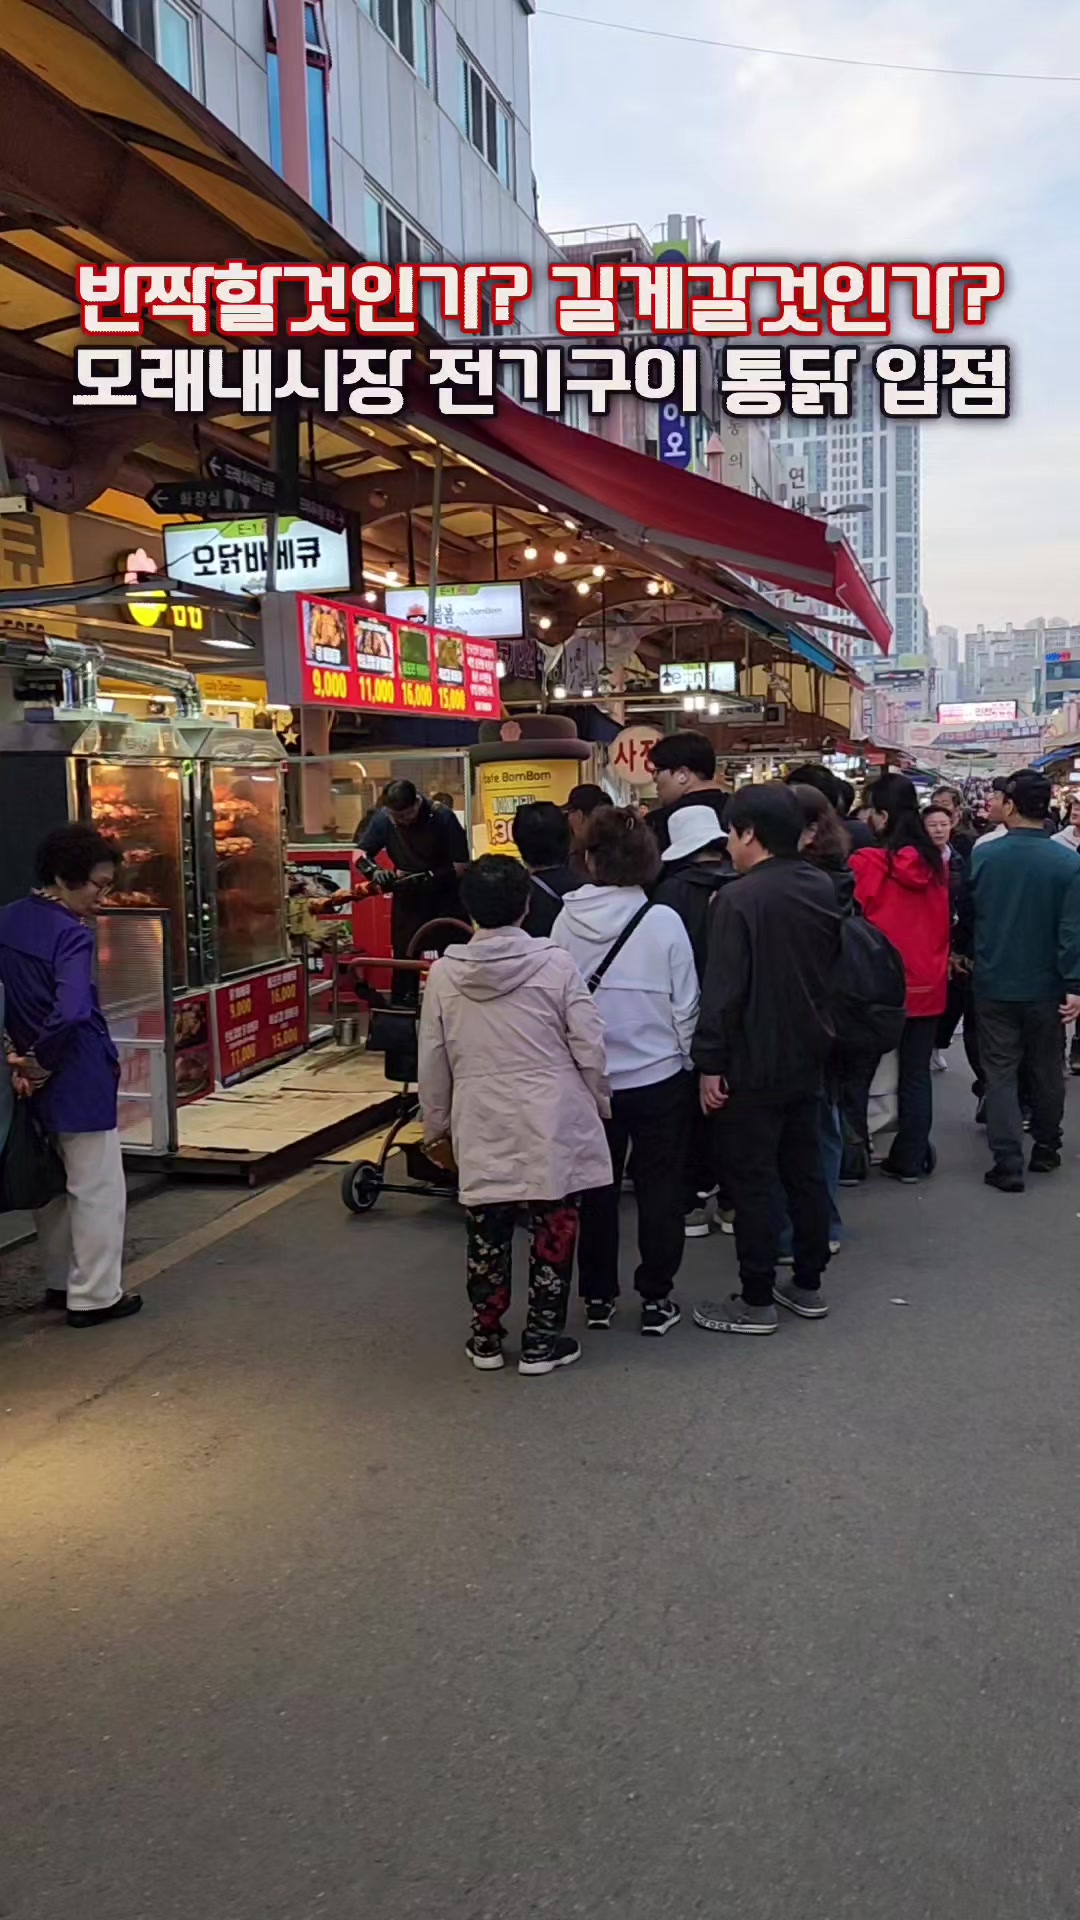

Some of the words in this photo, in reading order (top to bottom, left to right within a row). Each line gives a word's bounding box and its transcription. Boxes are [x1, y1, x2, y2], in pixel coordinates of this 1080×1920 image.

[179, 490, 221, 507] 화장실
[312, 669, 347, 698] 9,000
[358, 676, 395, 704] 11,000
